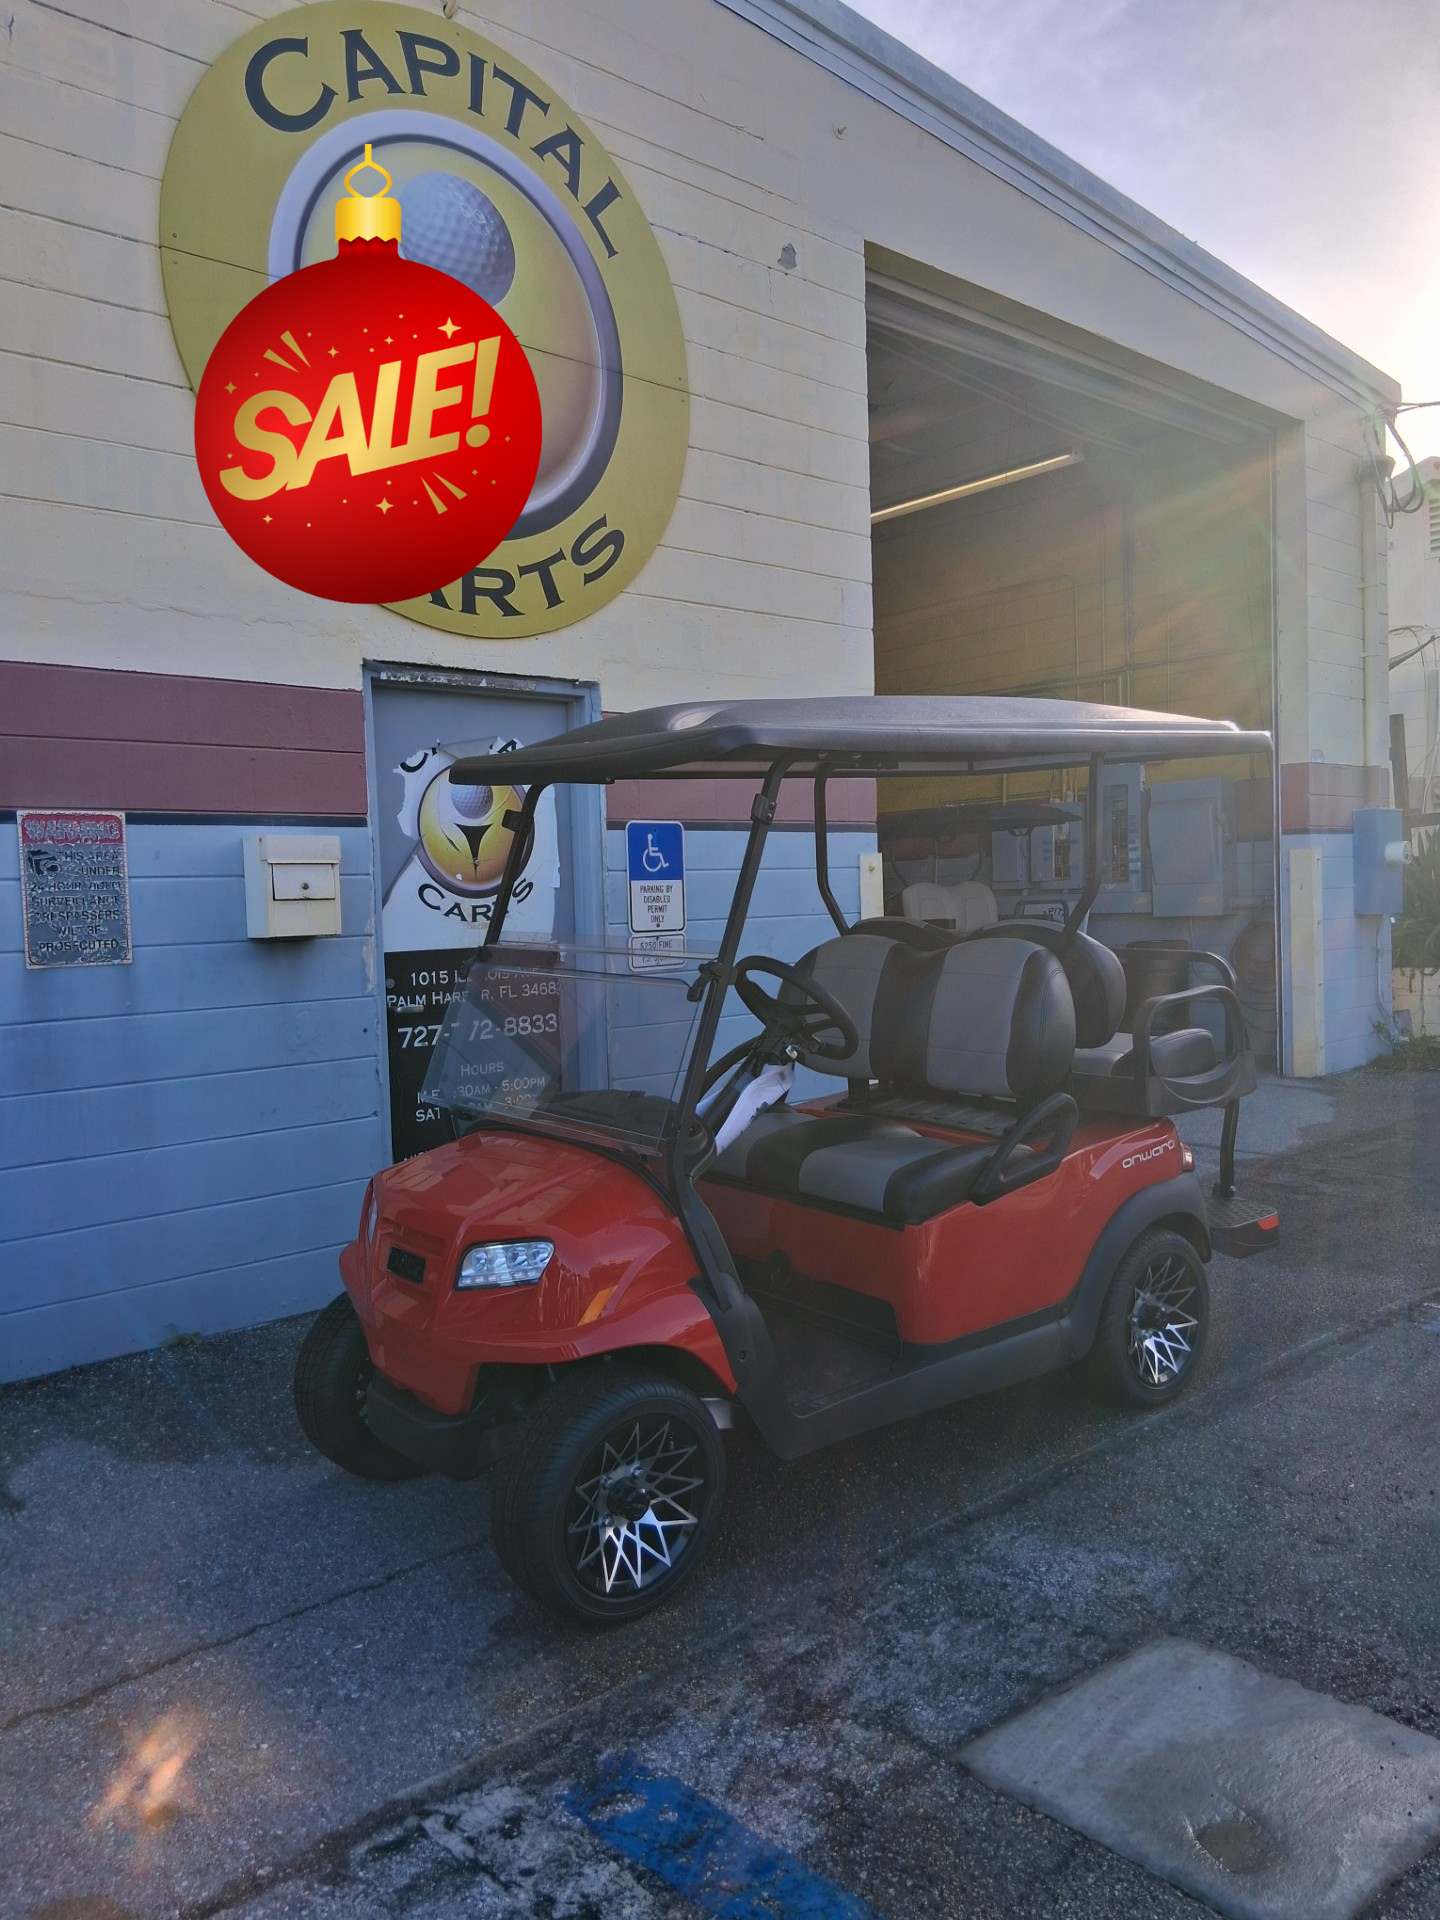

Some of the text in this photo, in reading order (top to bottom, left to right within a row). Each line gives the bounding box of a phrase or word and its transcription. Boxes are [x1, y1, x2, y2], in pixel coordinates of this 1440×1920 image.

[244, 28, 624, 259] CAPITAL
[428, 513, 626, 617] RTS
[640, 884, 674, 893] PARKING BY
[418, 878, 534, 924] CARS
[643, 895, 671, 903] DISABLED
[647, 904, 668, 913] PERMIT
[650, 914, 665, 923] ONLY
[56, 925, 83, 936] WIL
[38, 938, 119, 952] PROSECUTED
[658, 940, 673, 948] FINE
[411, 970, 449, 986] 1015
[387, 980, 560, 1008] PALM HARR, FL 3468
[460, 1061, 504, 1077] HOURS
[501, 1077, 546, 1092] 5:00PM
